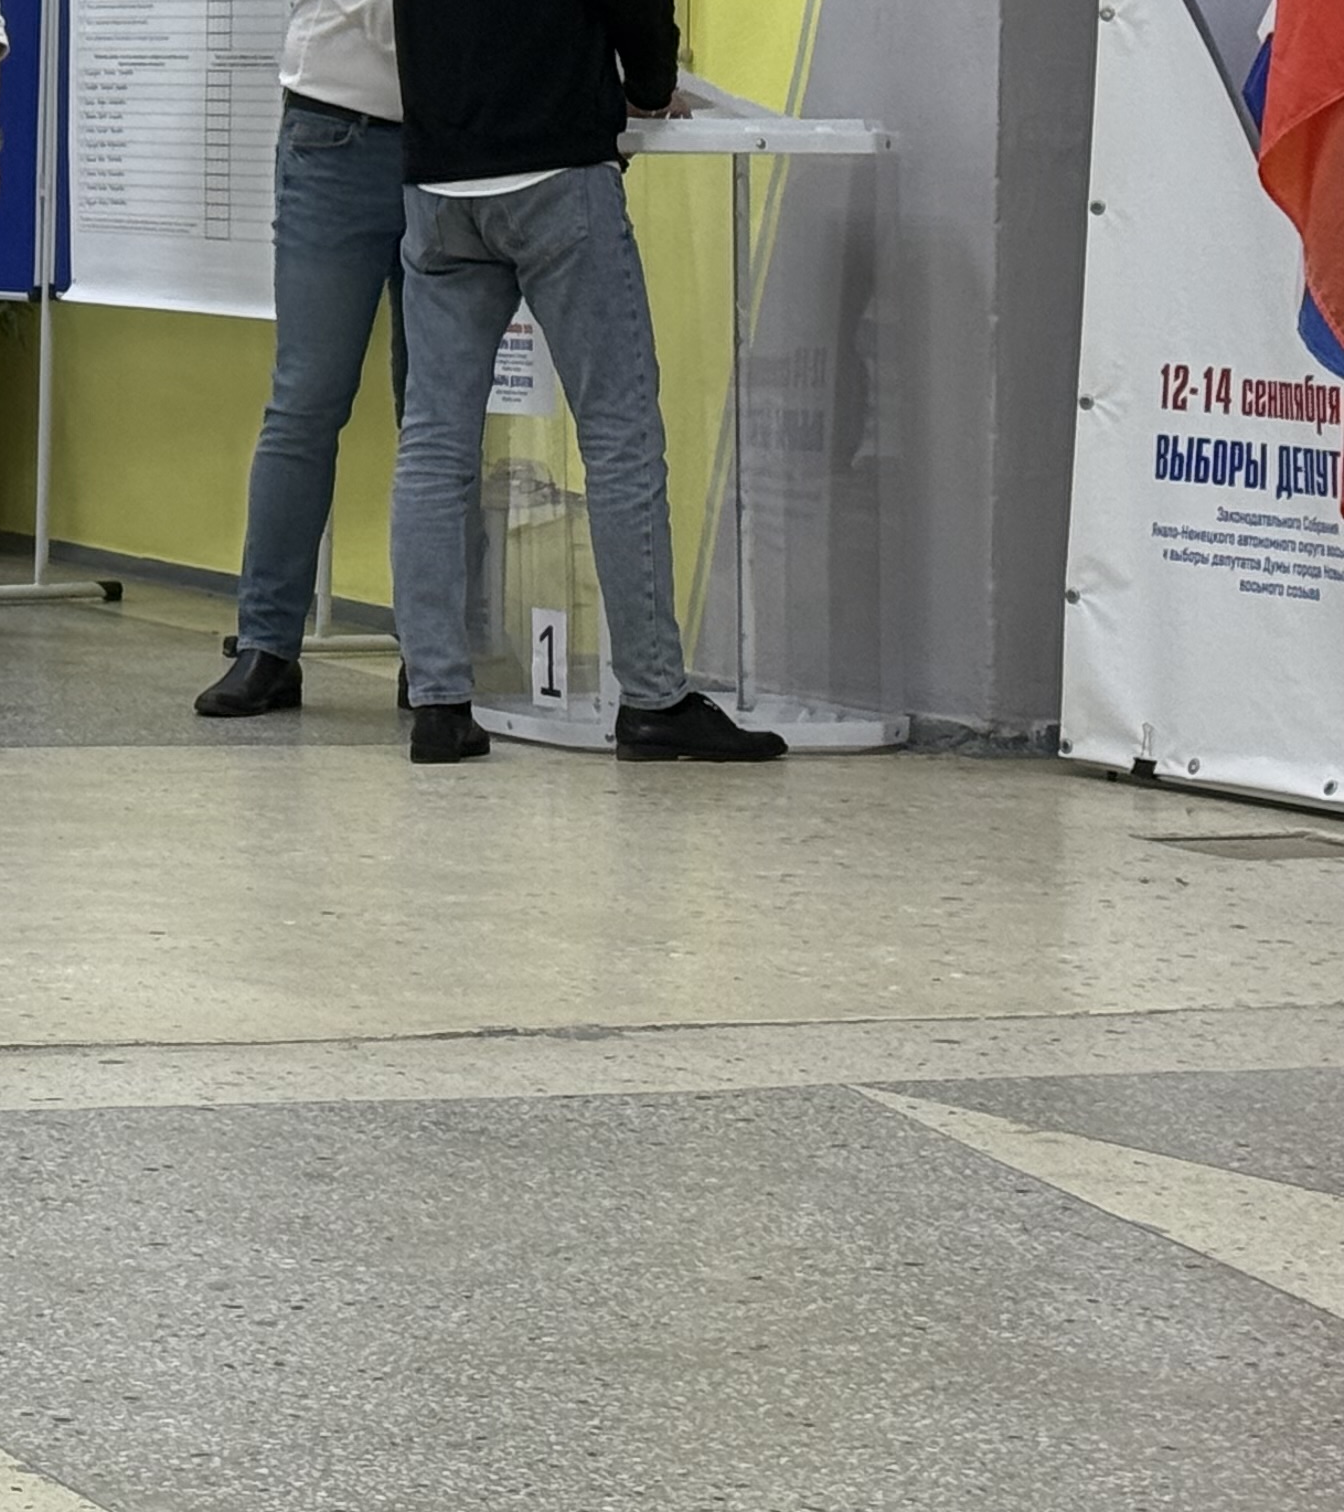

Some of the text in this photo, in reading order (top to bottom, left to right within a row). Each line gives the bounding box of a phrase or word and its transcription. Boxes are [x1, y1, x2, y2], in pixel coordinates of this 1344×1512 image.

[1161, 363, 1341, 436] 12-14 сентября
[1155, 434, 1267, 490] ВЫБОРЫ
[539, 624, 562, 699] 1
